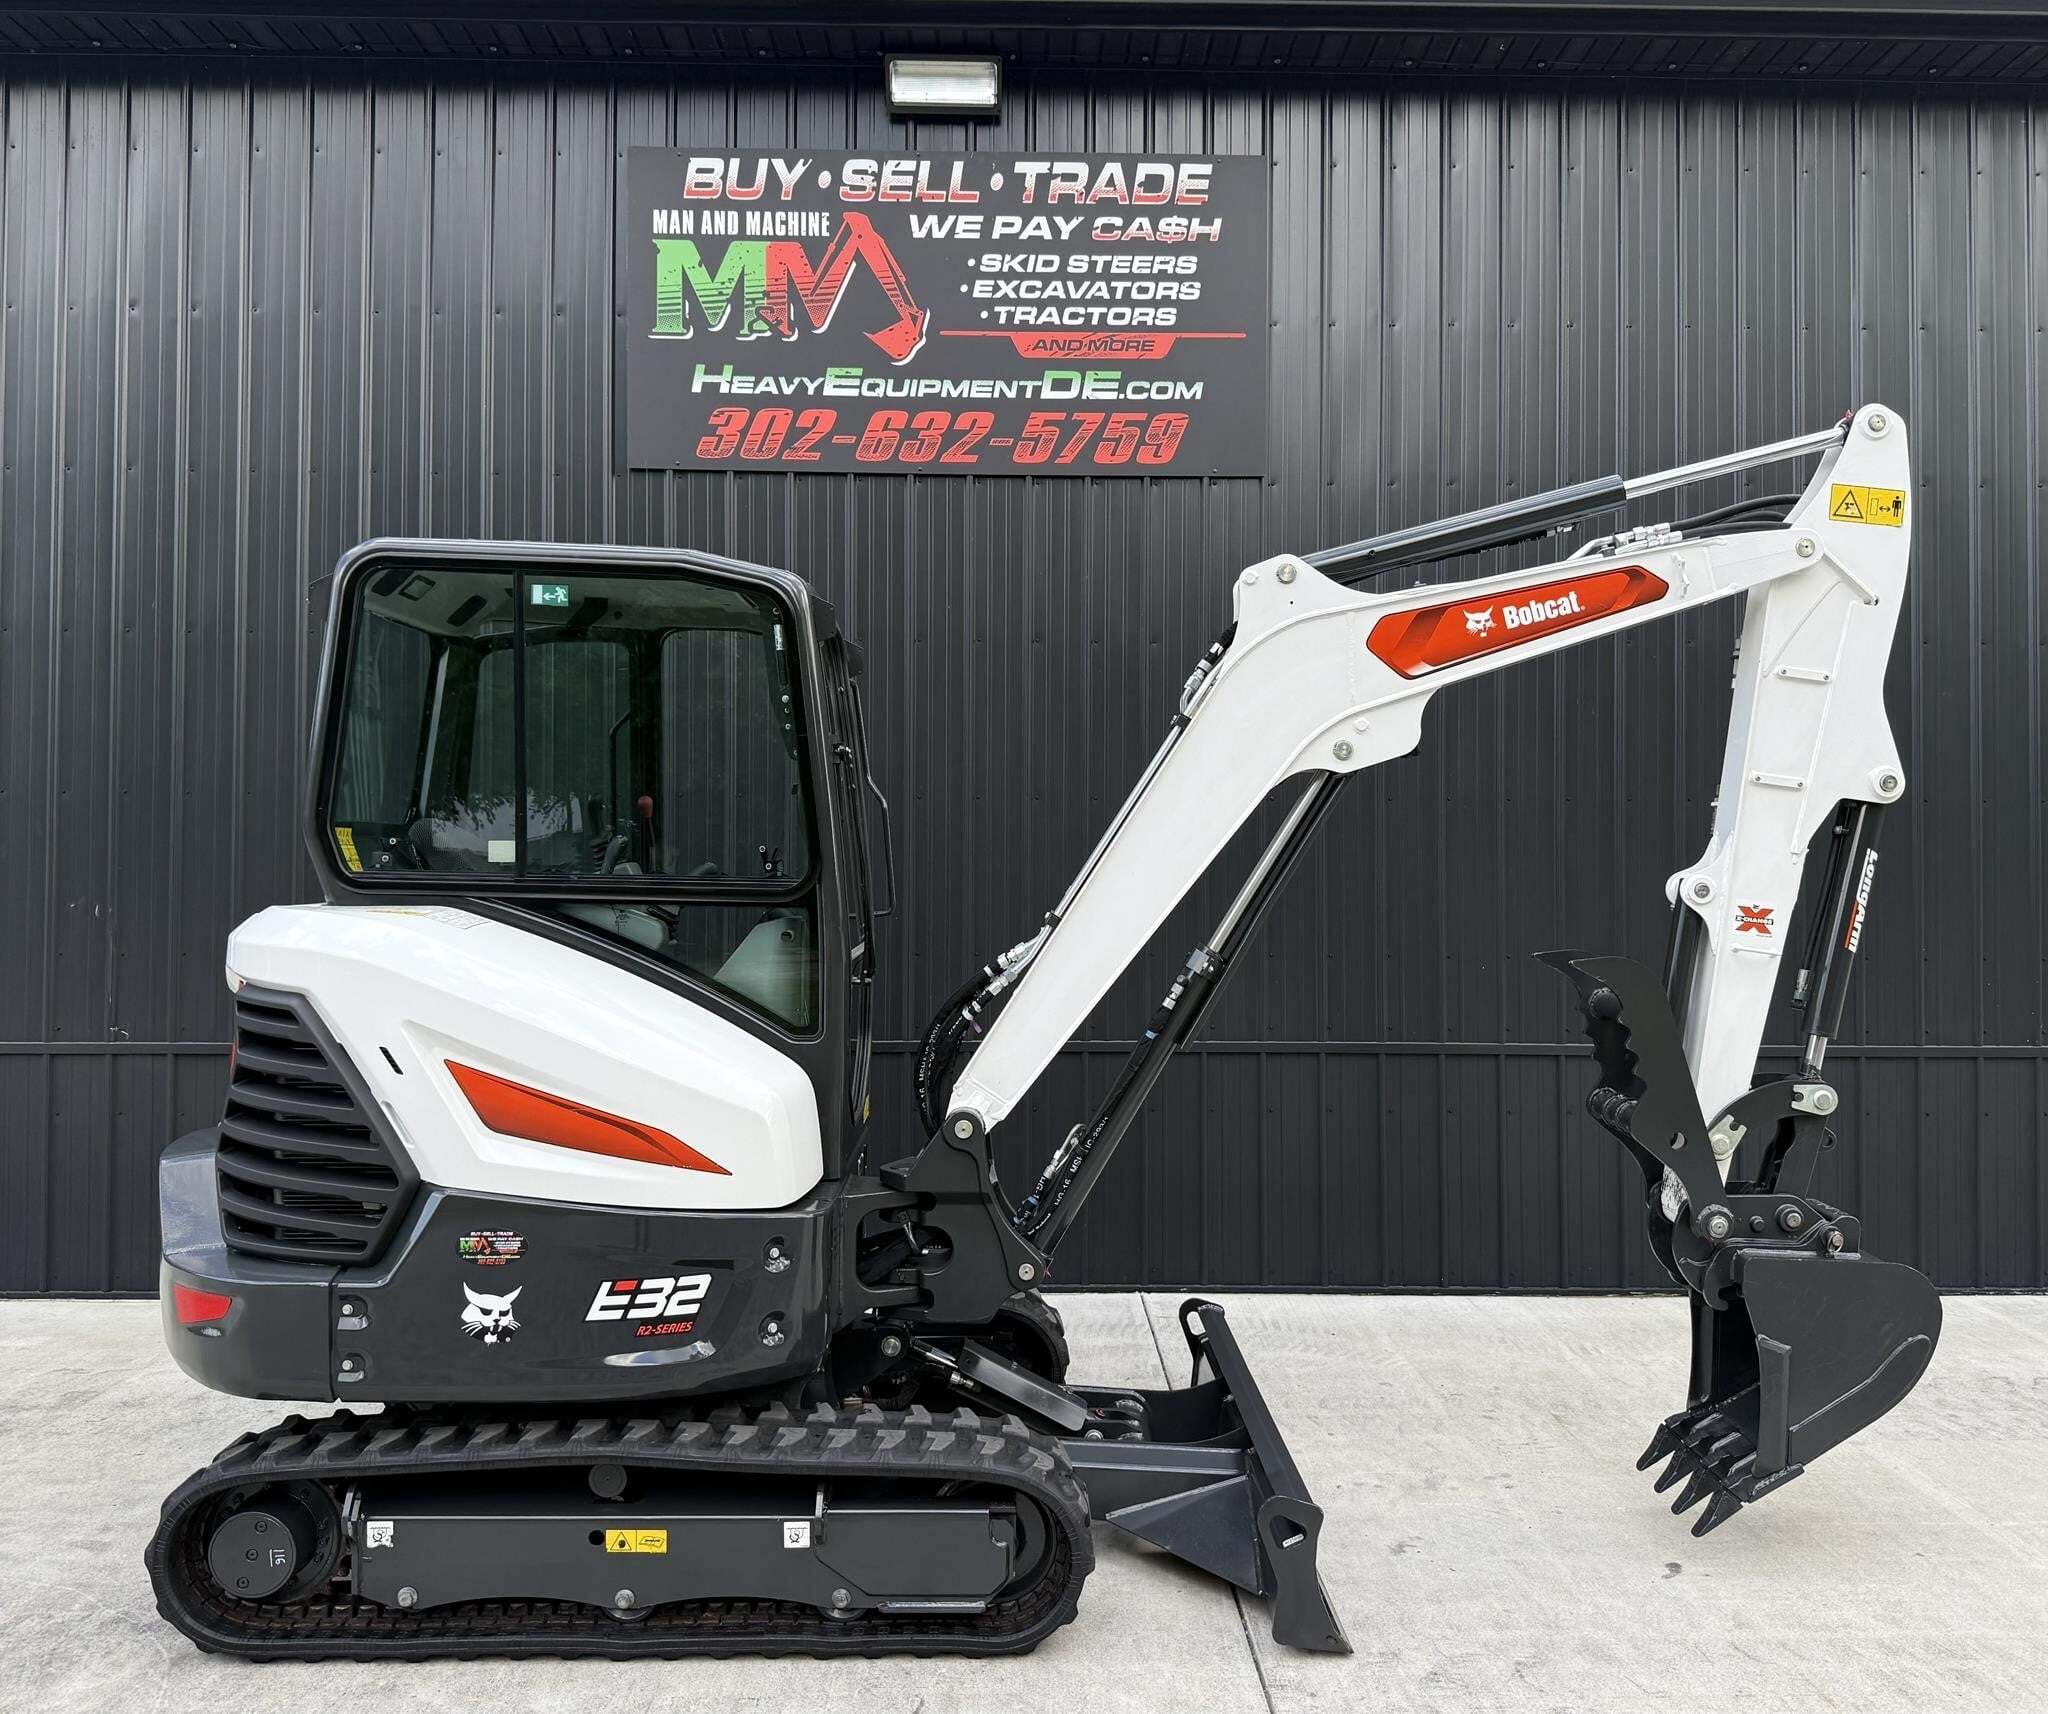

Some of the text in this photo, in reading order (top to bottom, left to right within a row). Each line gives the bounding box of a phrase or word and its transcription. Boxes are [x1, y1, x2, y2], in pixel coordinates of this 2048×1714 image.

[684, 157, 1213, 205] BUY SELL TRADE
[652, 209, 830, 237] MAN AND MACHINE
[909, 214, 984, 239] WE
[991, 215, 1085, 240] PAY
[979, 254, 1198, 274] SKID STEERS
[972, 280, 1201, 300] EXCAVATORS
[993, 306, 1178, 326] TRACTORS
[1032, 339, 1155, 352] AND MORE
[696, 407, 1190, 464] 302-632-5759
[1503, 591, 1582, 630] Bobcat
[585, 1273, 712, 1321] E32
[637, 1321, 694, 1337] R2-SERIES
